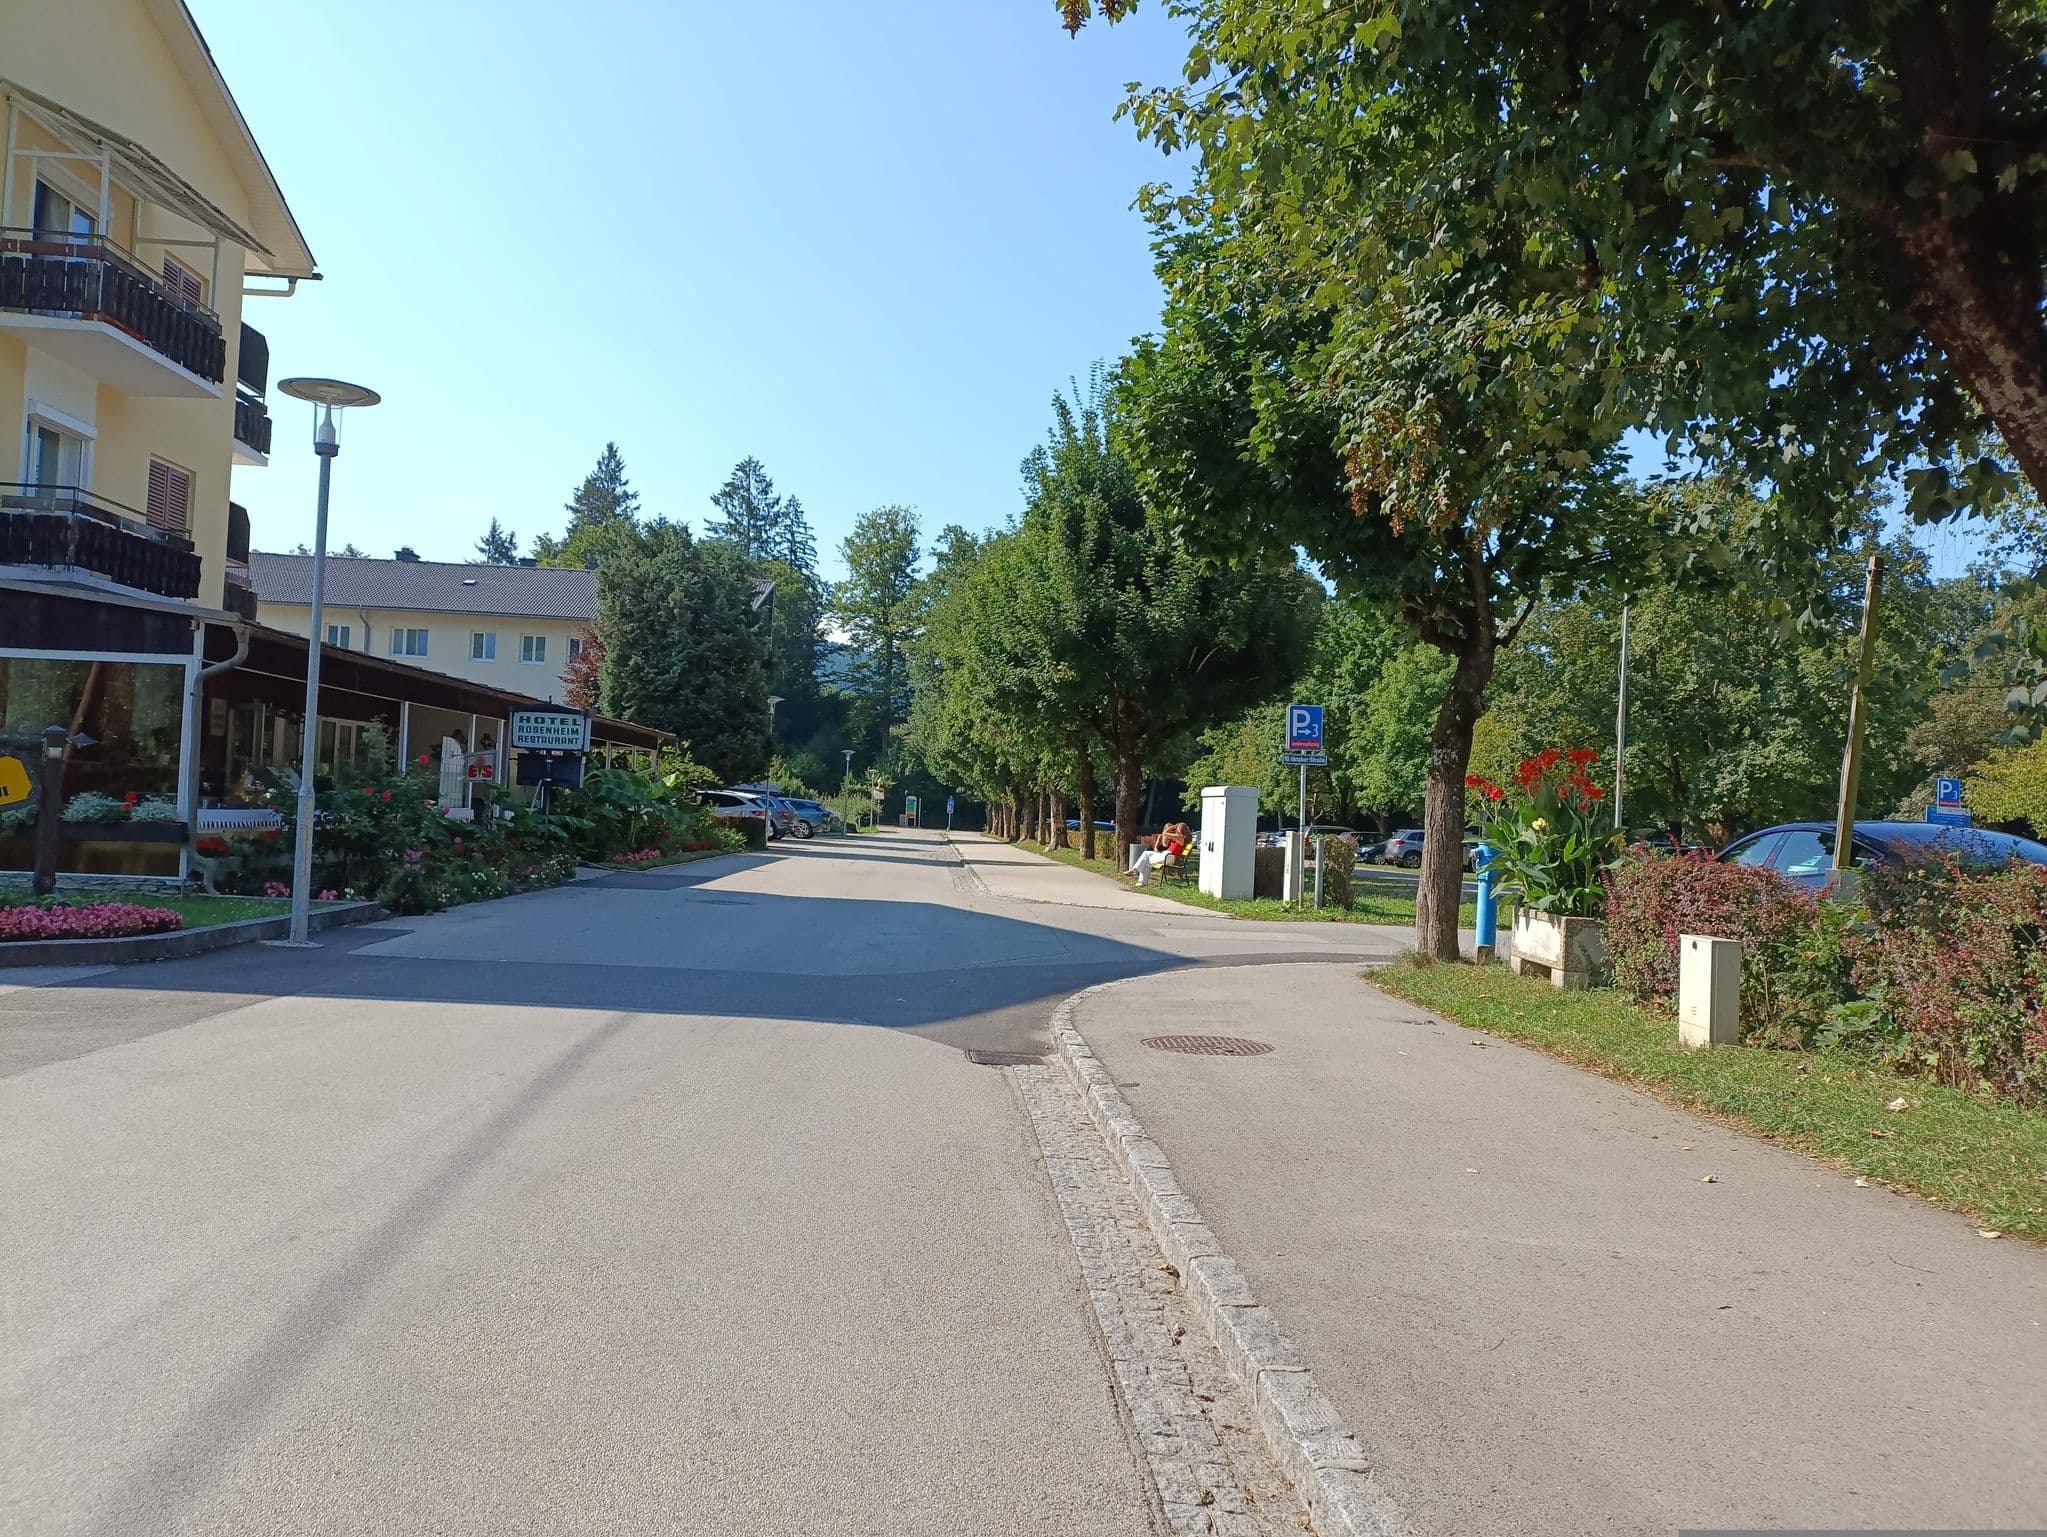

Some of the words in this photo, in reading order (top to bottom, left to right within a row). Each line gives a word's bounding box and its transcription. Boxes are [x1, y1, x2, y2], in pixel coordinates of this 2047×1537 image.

[519, 715, 581, 726] HOTEL
[1292, 709, 1311, 737] P
[518, 725, 579, 736] ROSENHEIM
[1311, 723, 1319, 738] 3
[517, 735, 579, 745] RESTAURANT
[1940, 781, 1952, 799] P
